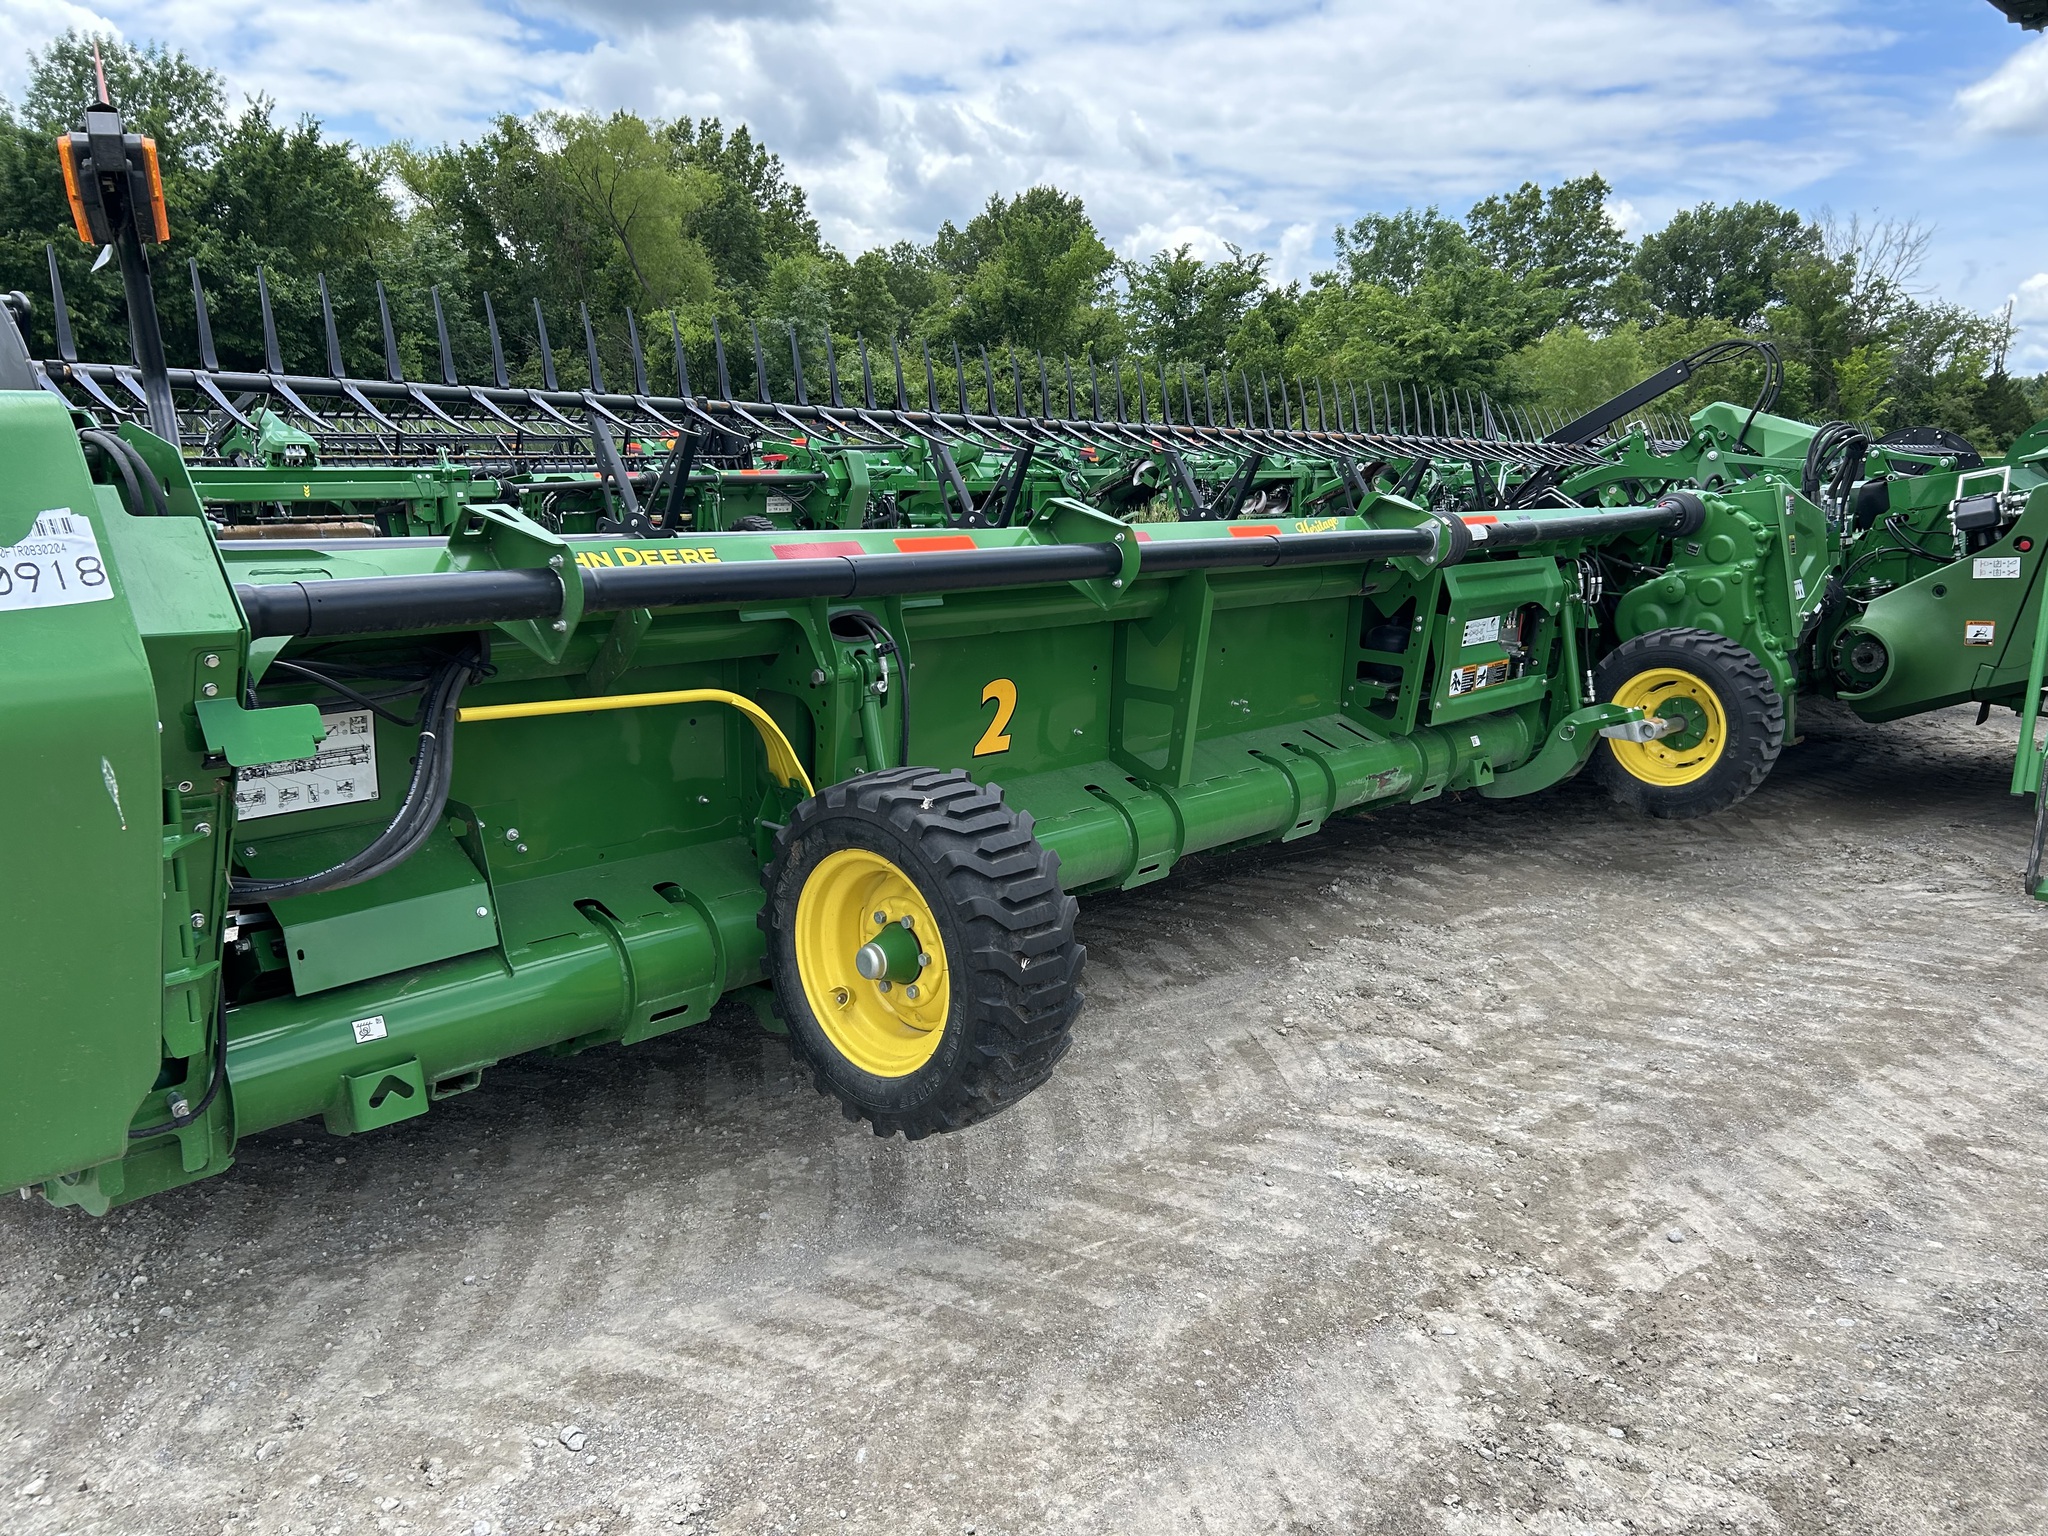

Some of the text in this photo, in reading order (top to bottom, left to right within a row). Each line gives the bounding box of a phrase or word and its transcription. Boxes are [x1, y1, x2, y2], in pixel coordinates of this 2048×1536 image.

[1295, 517, 1339, 533] Heritage
[0, 542, 67, 558] 0FTR0830204
[574, 547, 722, 568] HN DEERE
[972, 677, 1019, 758] 2
[943, 1001, 966, 1068] TRAC
